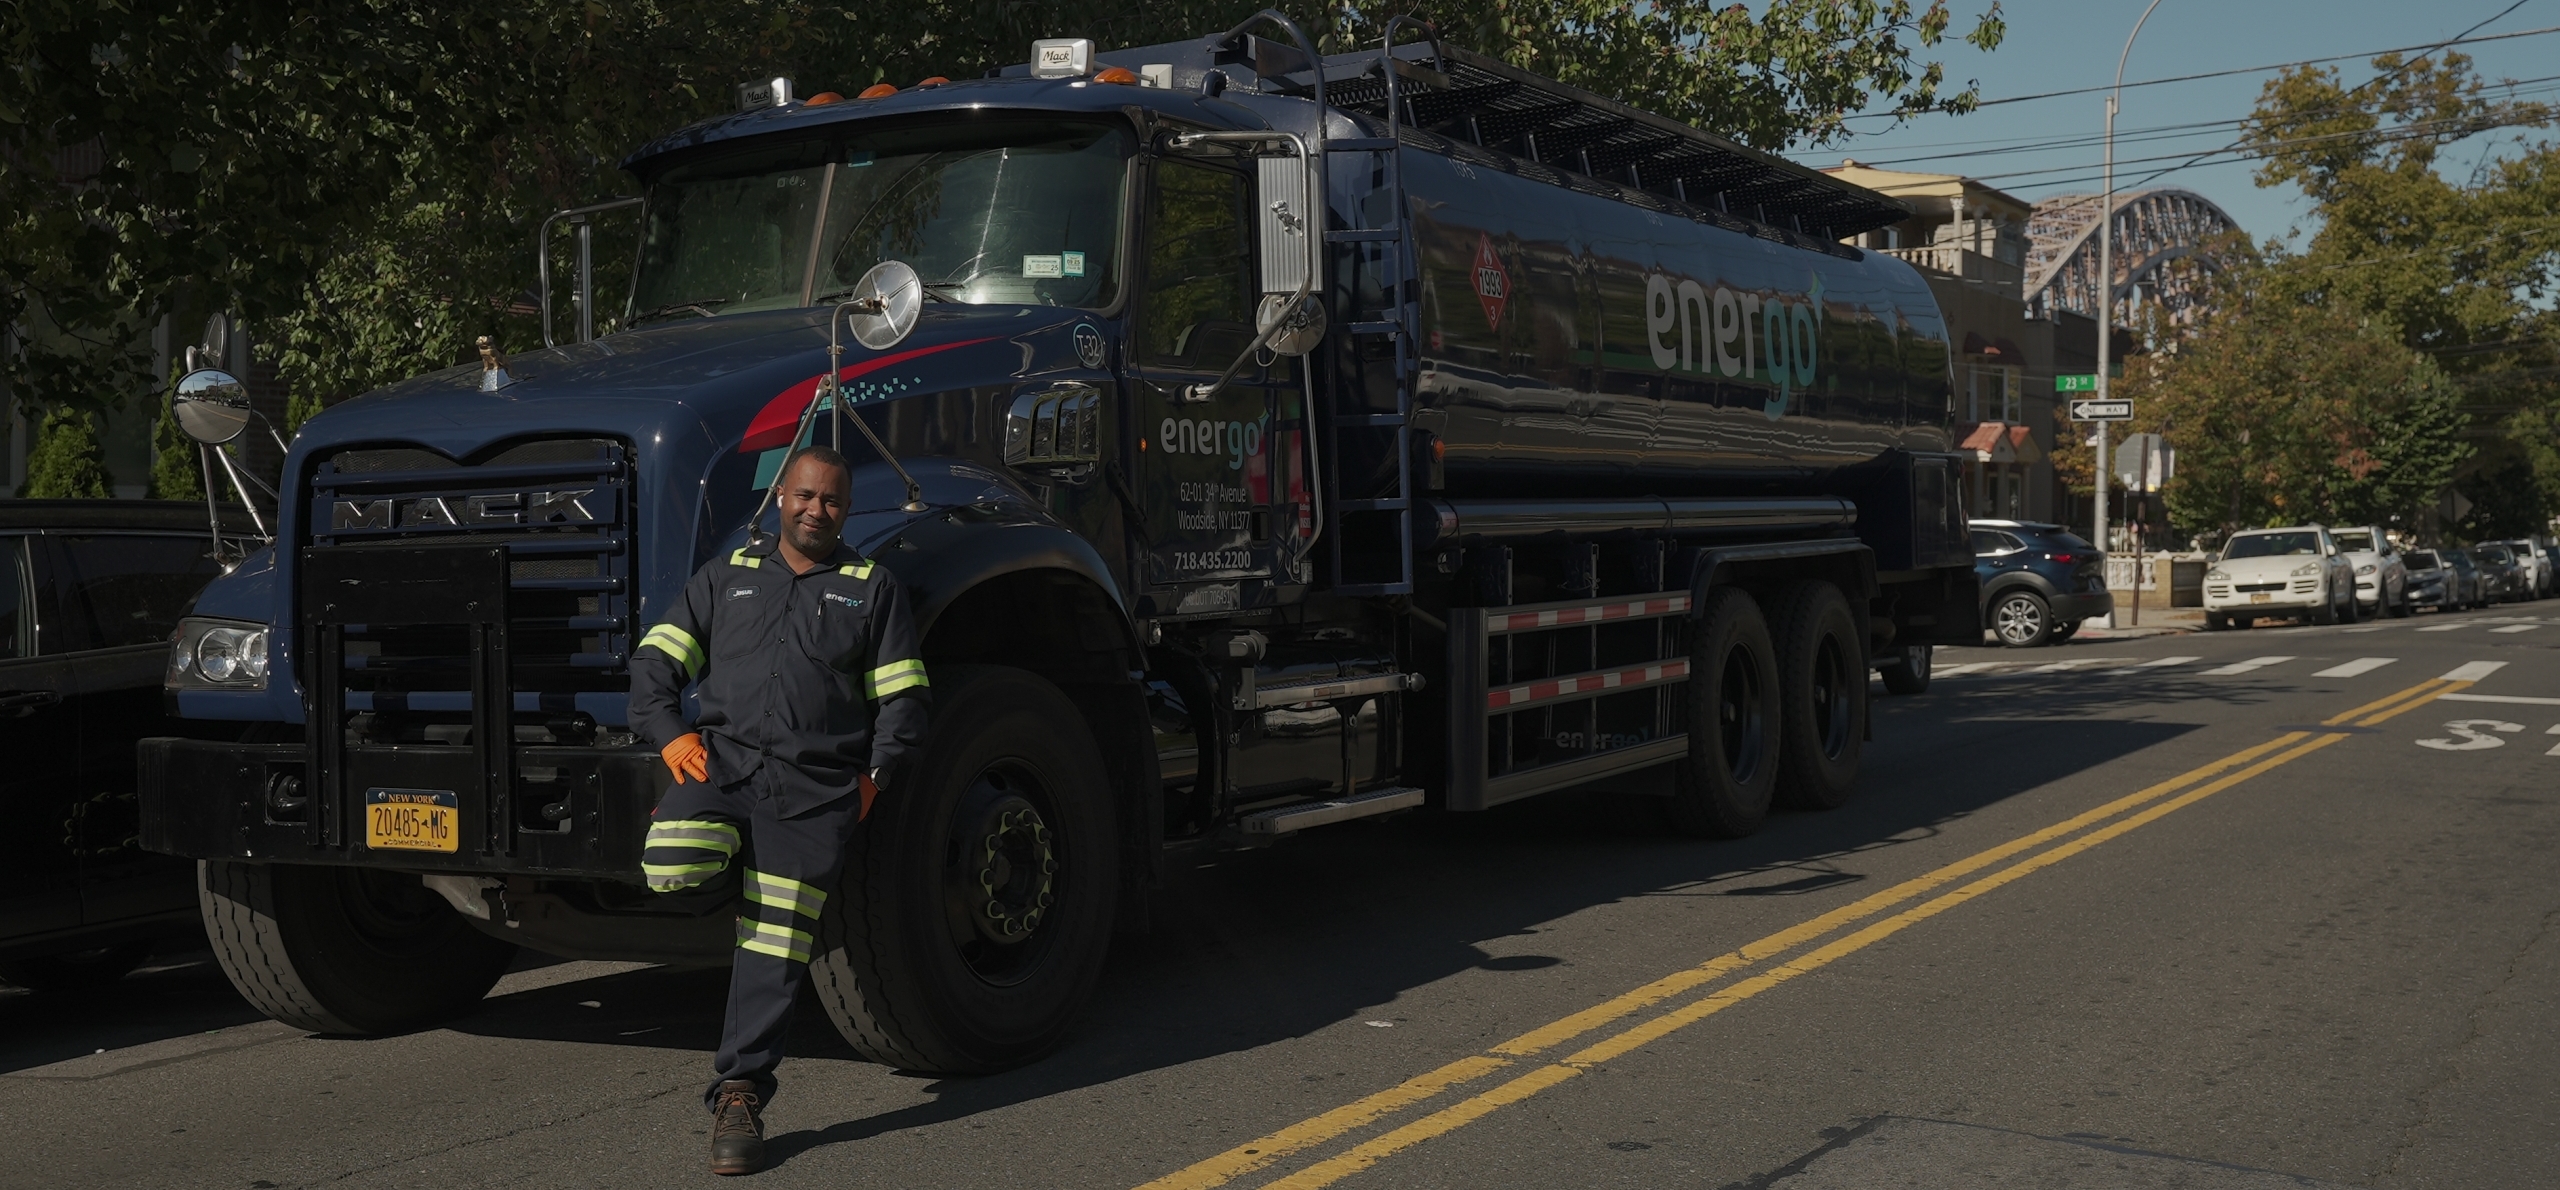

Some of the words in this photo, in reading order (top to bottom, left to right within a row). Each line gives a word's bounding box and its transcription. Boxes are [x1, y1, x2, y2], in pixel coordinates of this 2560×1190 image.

[1043, 50, 1070, 62] Mack
[745, 90, 769, 103] Mack
[1479, 269, 1502, 296] 1993
[1490, 305, 1496, 321] 3
[1076, 334, 1100, 357] T-32
[1646, 273, 1817, 422] energo
[2065, 377, 2078, 390] 23
[2080, 406, 2096, 414] ONE
[1160, 417, 1260, 471] energo
[1180, 482, 1203, 502] 62-01
[1219, 483, 1247, 503] Avenue
[331, 488, 595, 531] MACK
[1177, 509, 1218, 534] Woodside,
[1218, 511, 1230, 530] NY
[1230, 511, 1251, 530] 11377
[1174, 550, 1252, 571] 718.435.2200
[826, 593, 859, 607] energo
[388, 794, 411, 803] NEW
[412, 795, 435, 805] YORK
[375, 807, 420, 838] 20485
[430, 809, 448, 839] MG
[388, 839, 437, 848] COMMERCIAL
